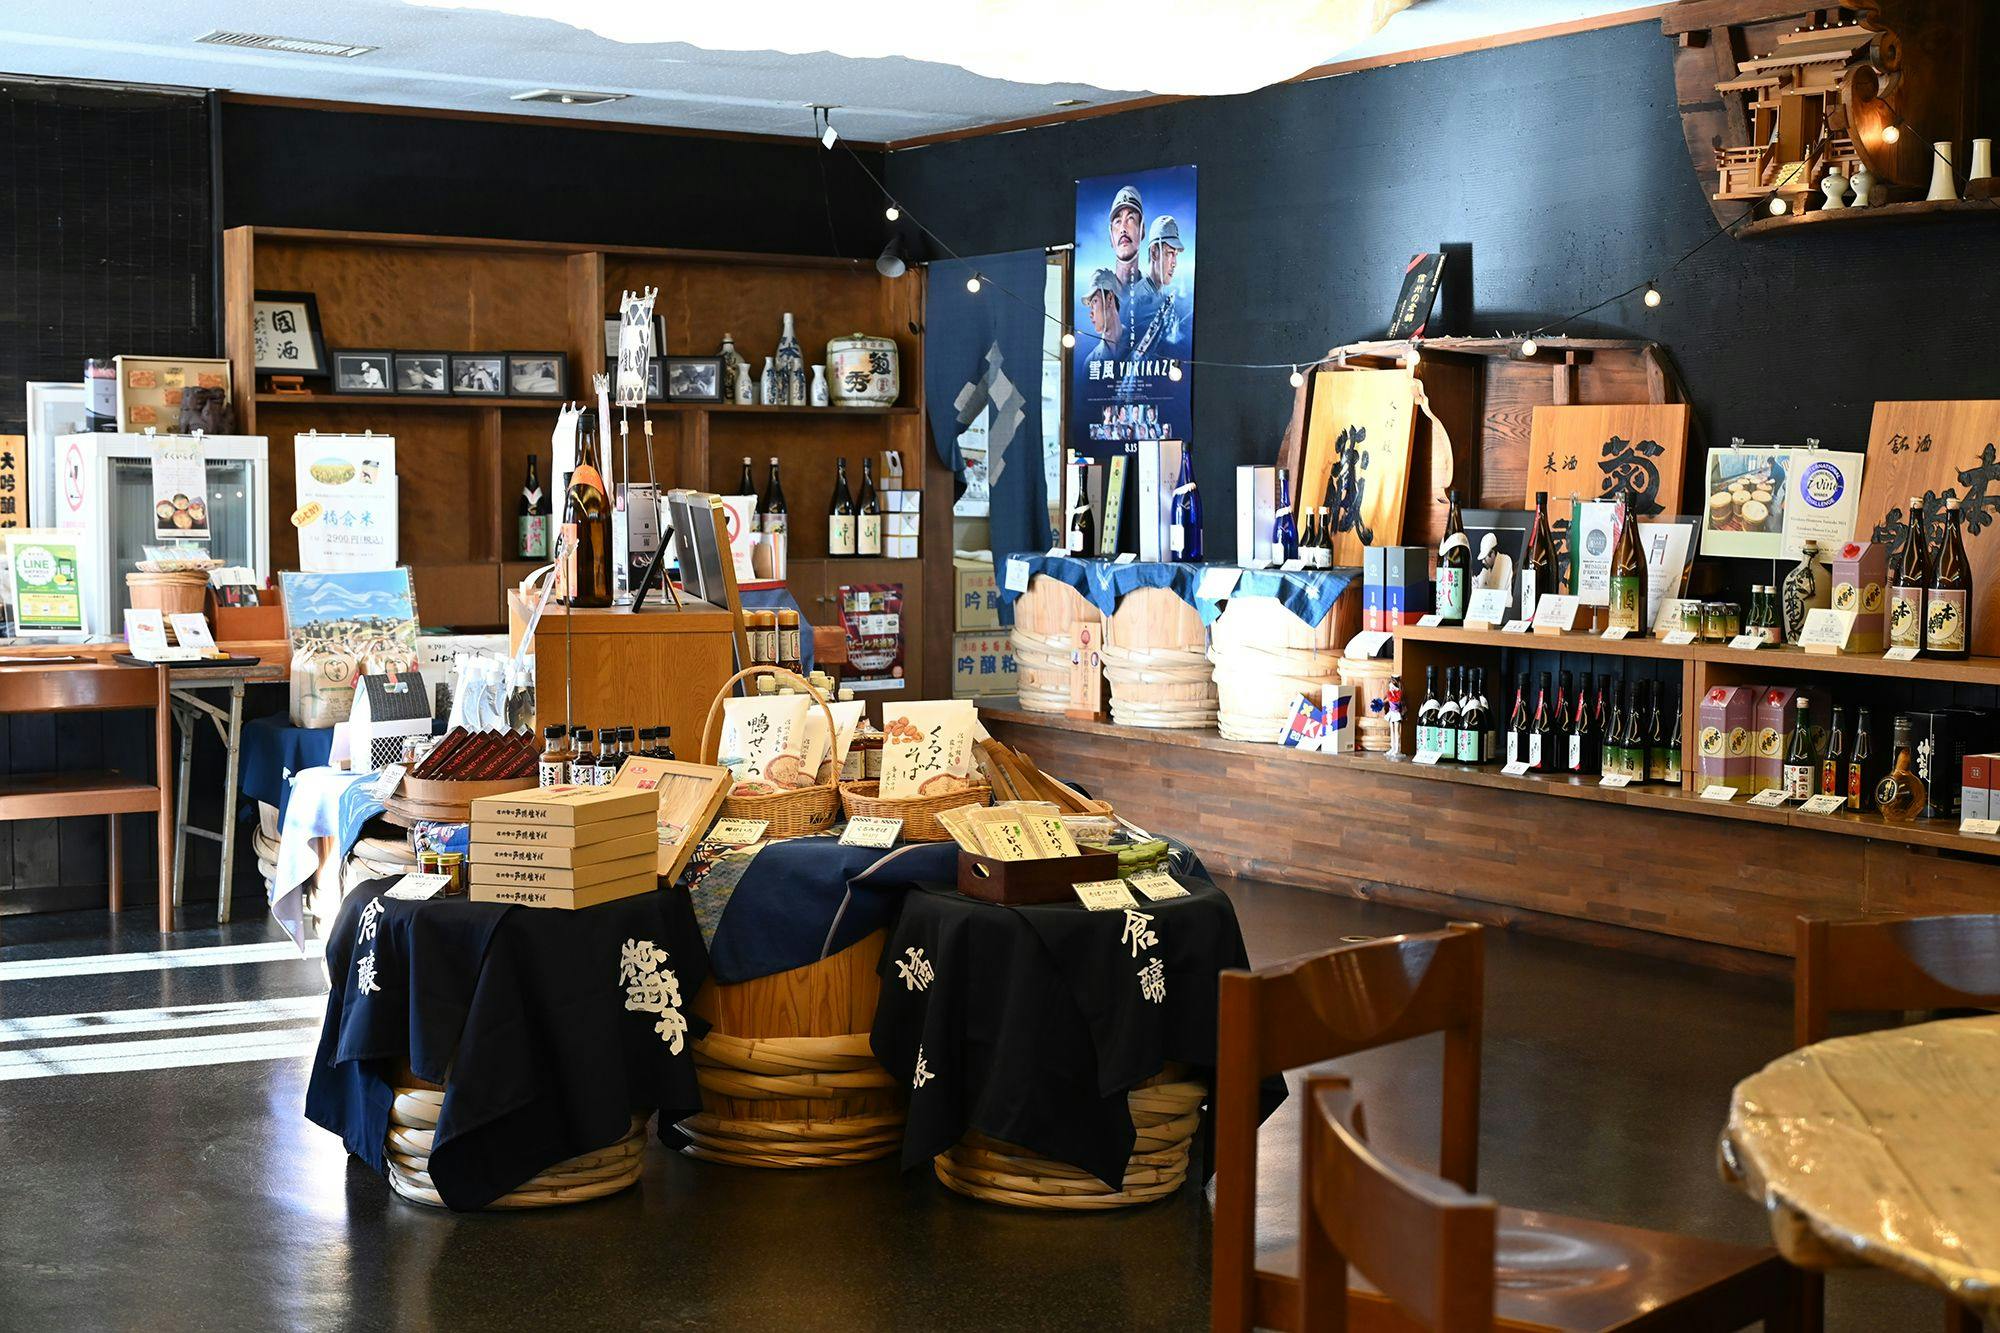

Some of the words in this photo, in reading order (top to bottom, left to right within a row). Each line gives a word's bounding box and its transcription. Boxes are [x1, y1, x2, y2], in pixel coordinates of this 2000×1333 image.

[1088, 360, 1115, 380] 雪風
[1124, 442, 1138, 453] 8.15
[23, 559, 50, 570] LINE
[957, 655, 1018, 676] 吟醸粕
[747, 712, 771, 776] 鴨せいろ
[927, 725, 943, 771] くるみ
[904, 746, 926, 781] そば
